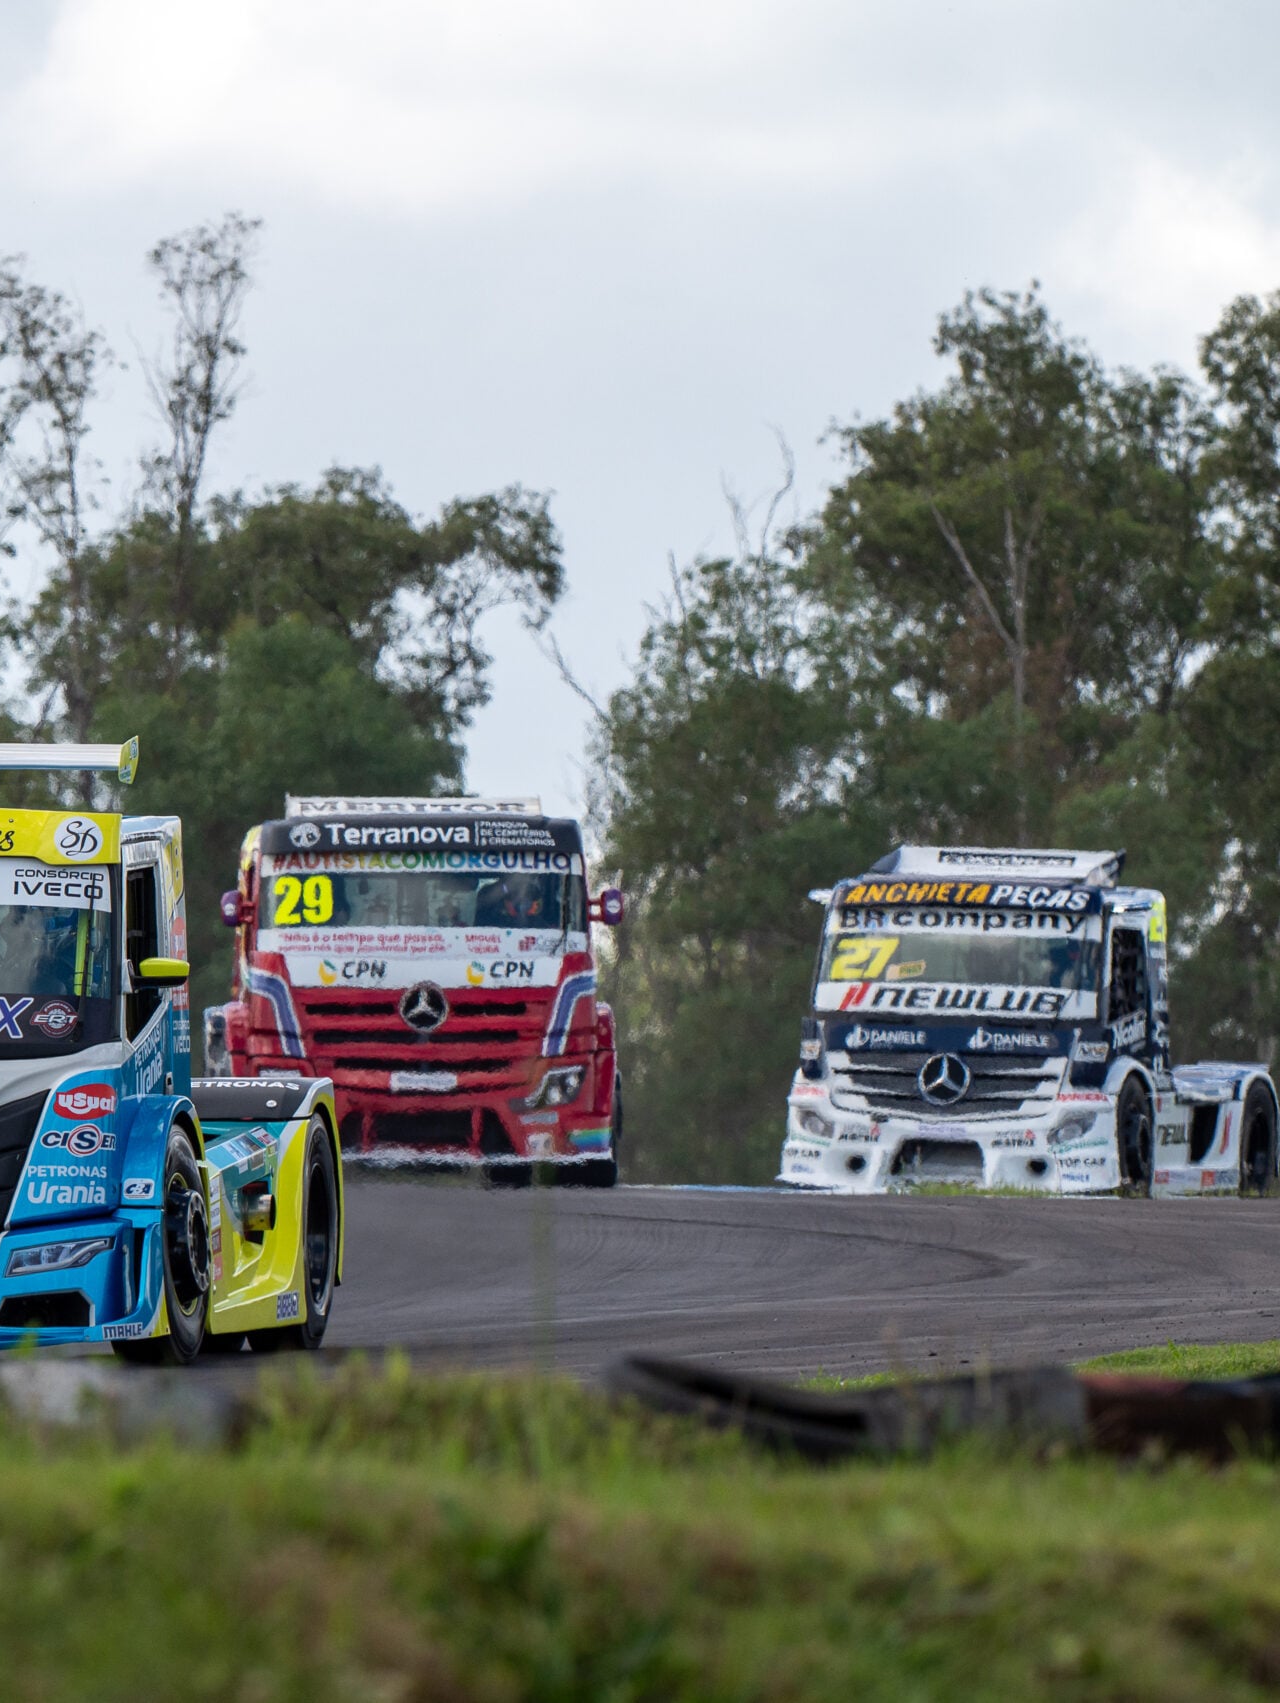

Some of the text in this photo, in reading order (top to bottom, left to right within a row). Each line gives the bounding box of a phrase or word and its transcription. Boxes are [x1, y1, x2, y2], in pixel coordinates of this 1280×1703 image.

[325, 823, 470, 845] Terranova
[14, 868, 104, 882] CONSÓRCIO
[13, 881, 103, 900] IVECO
[273, 874, 334, 925] 29
[844, 882, 991, 904] ANCHIETA
[830, 937, 900, 980] 27
[342, 960, 387, 979] CPN
[490, 960, 535, 978] CPN
[33, 1013, 79, 1024] ERT
[191, 1081, 300, 1090] ETRONAS
[41, 1126, 116, 1154] CISER
[28, 1165, 107, 1178] PETRONAS
[27, 1181, 106, 1204] Urania
[103, 1323, 142, 1338] MAHLE
